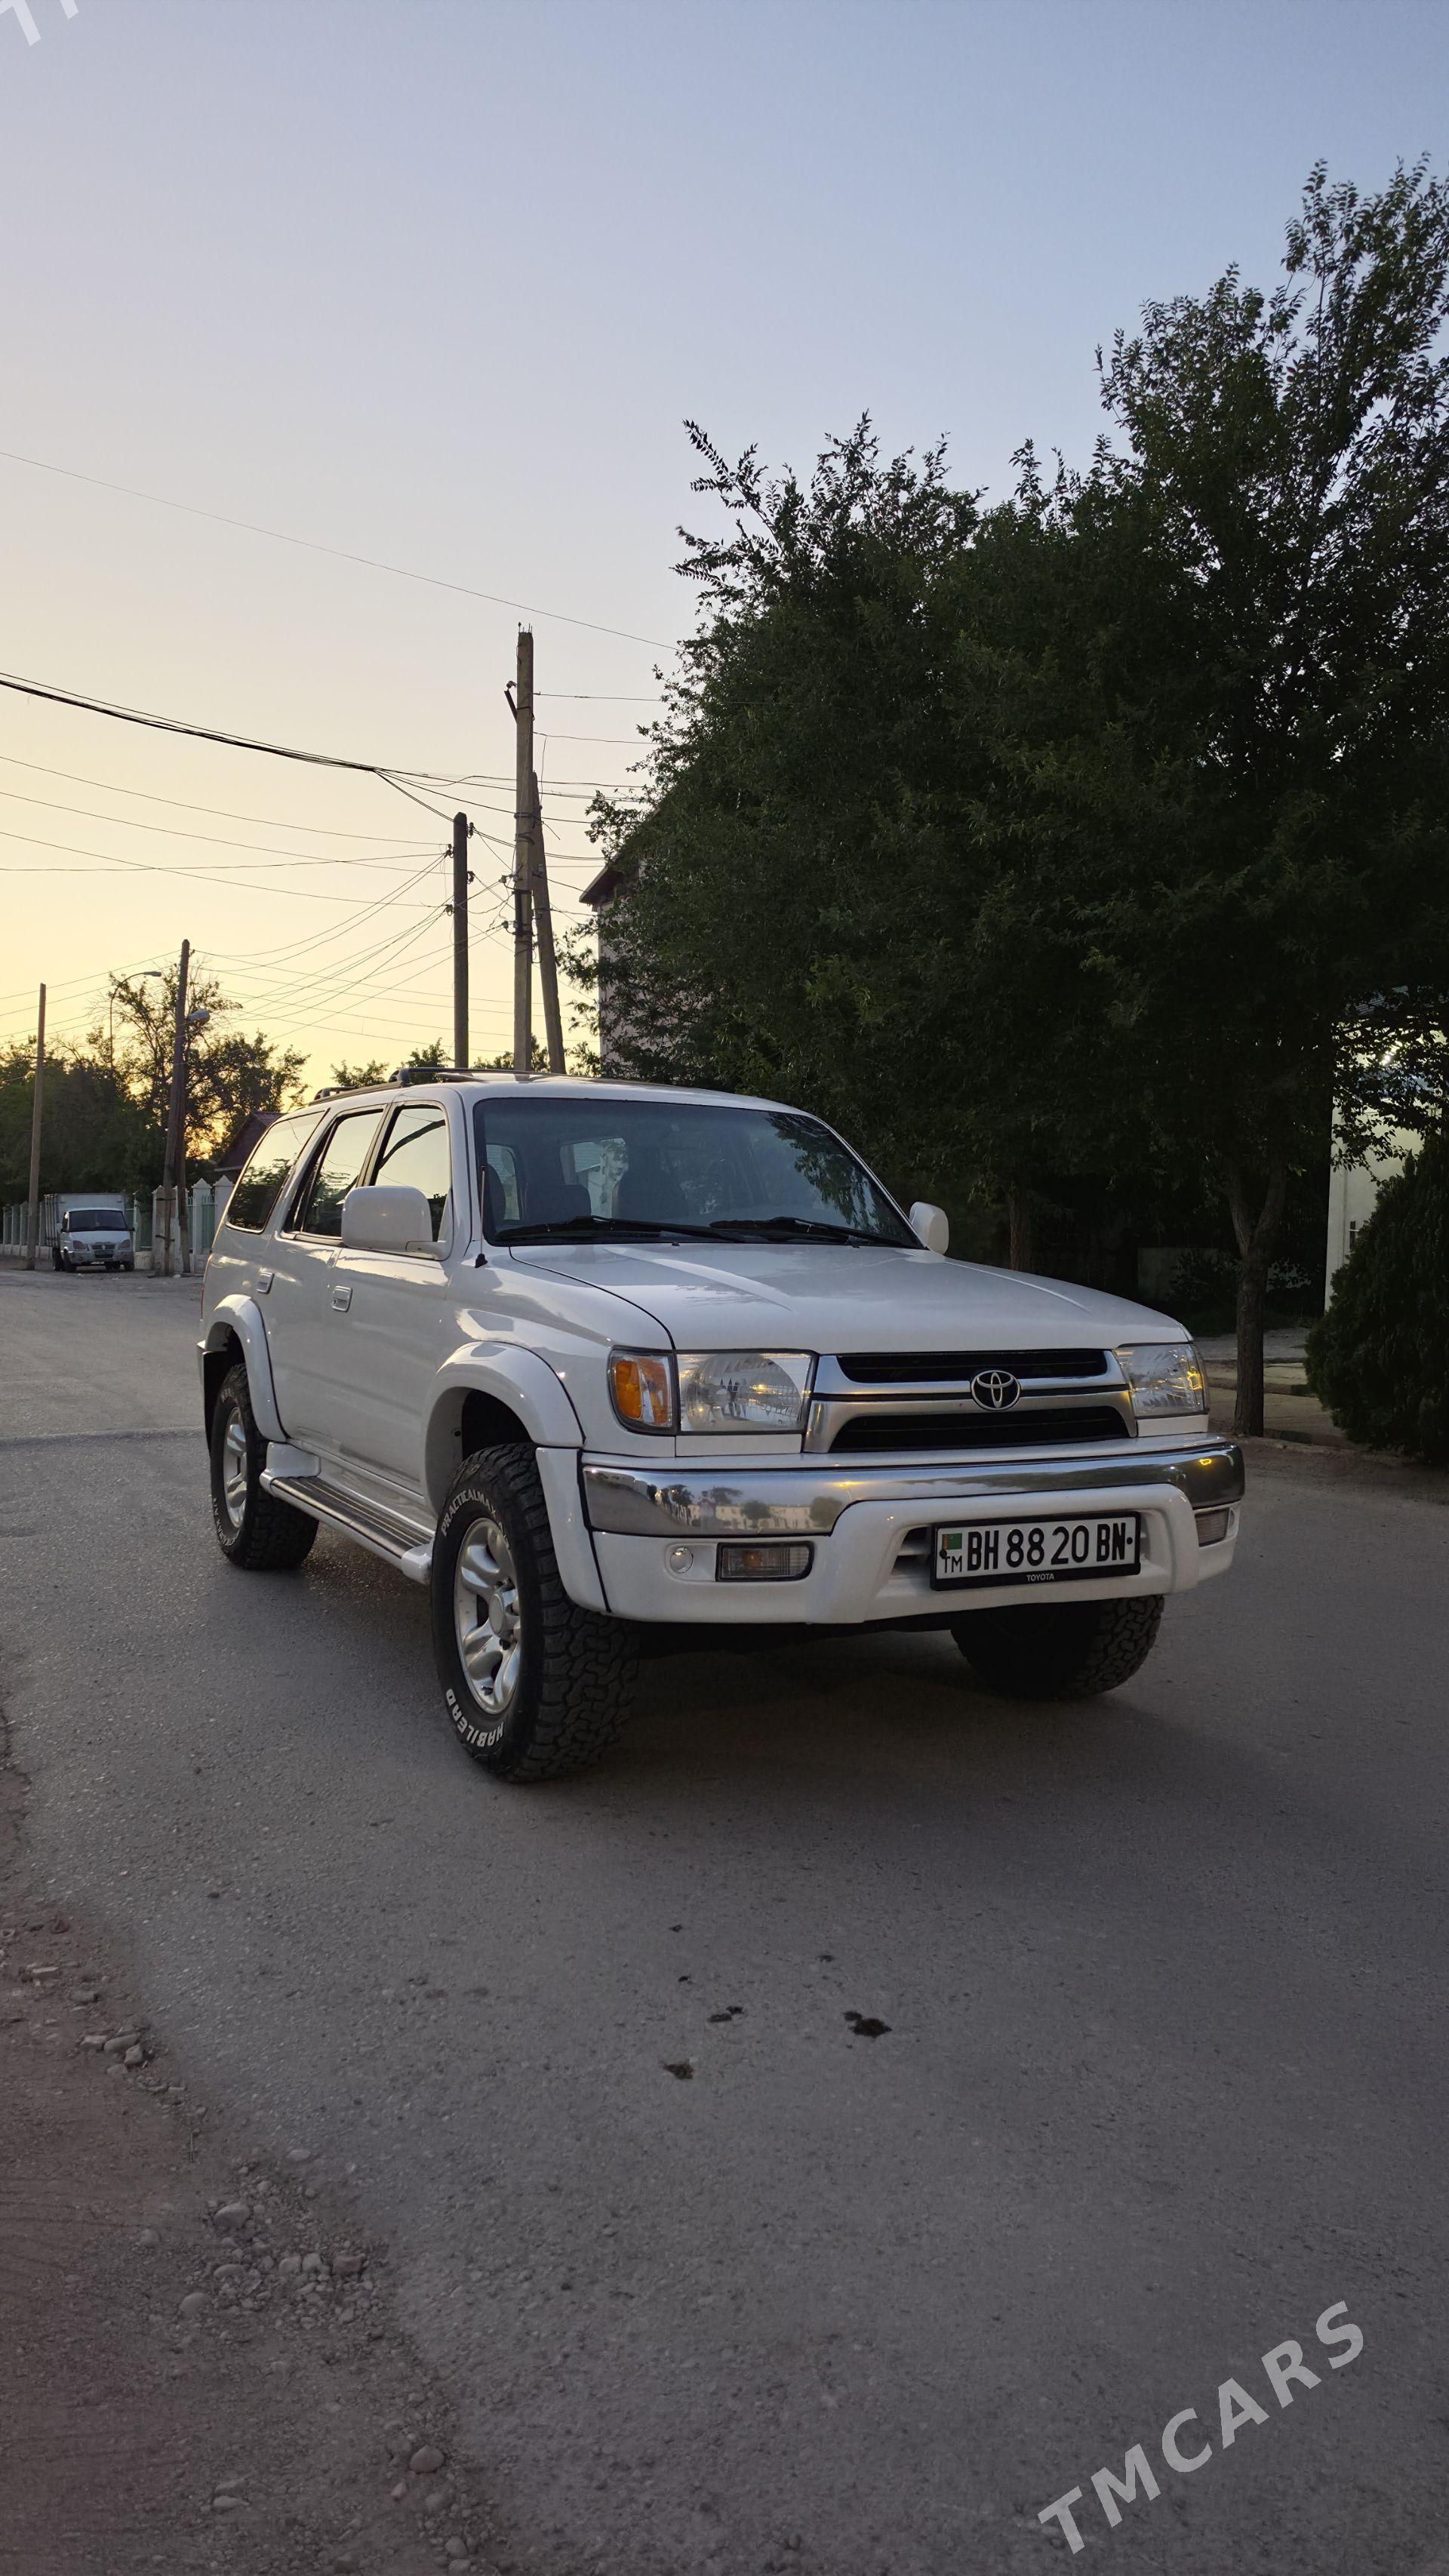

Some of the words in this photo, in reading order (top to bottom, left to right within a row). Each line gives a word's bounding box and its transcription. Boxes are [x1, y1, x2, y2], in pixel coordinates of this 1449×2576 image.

[943, 1555, 963, 1574] TM
[1026, 1573, 1055, 1582] TOYOTA
[445, 1688, 505, 1748] HABILEAD
